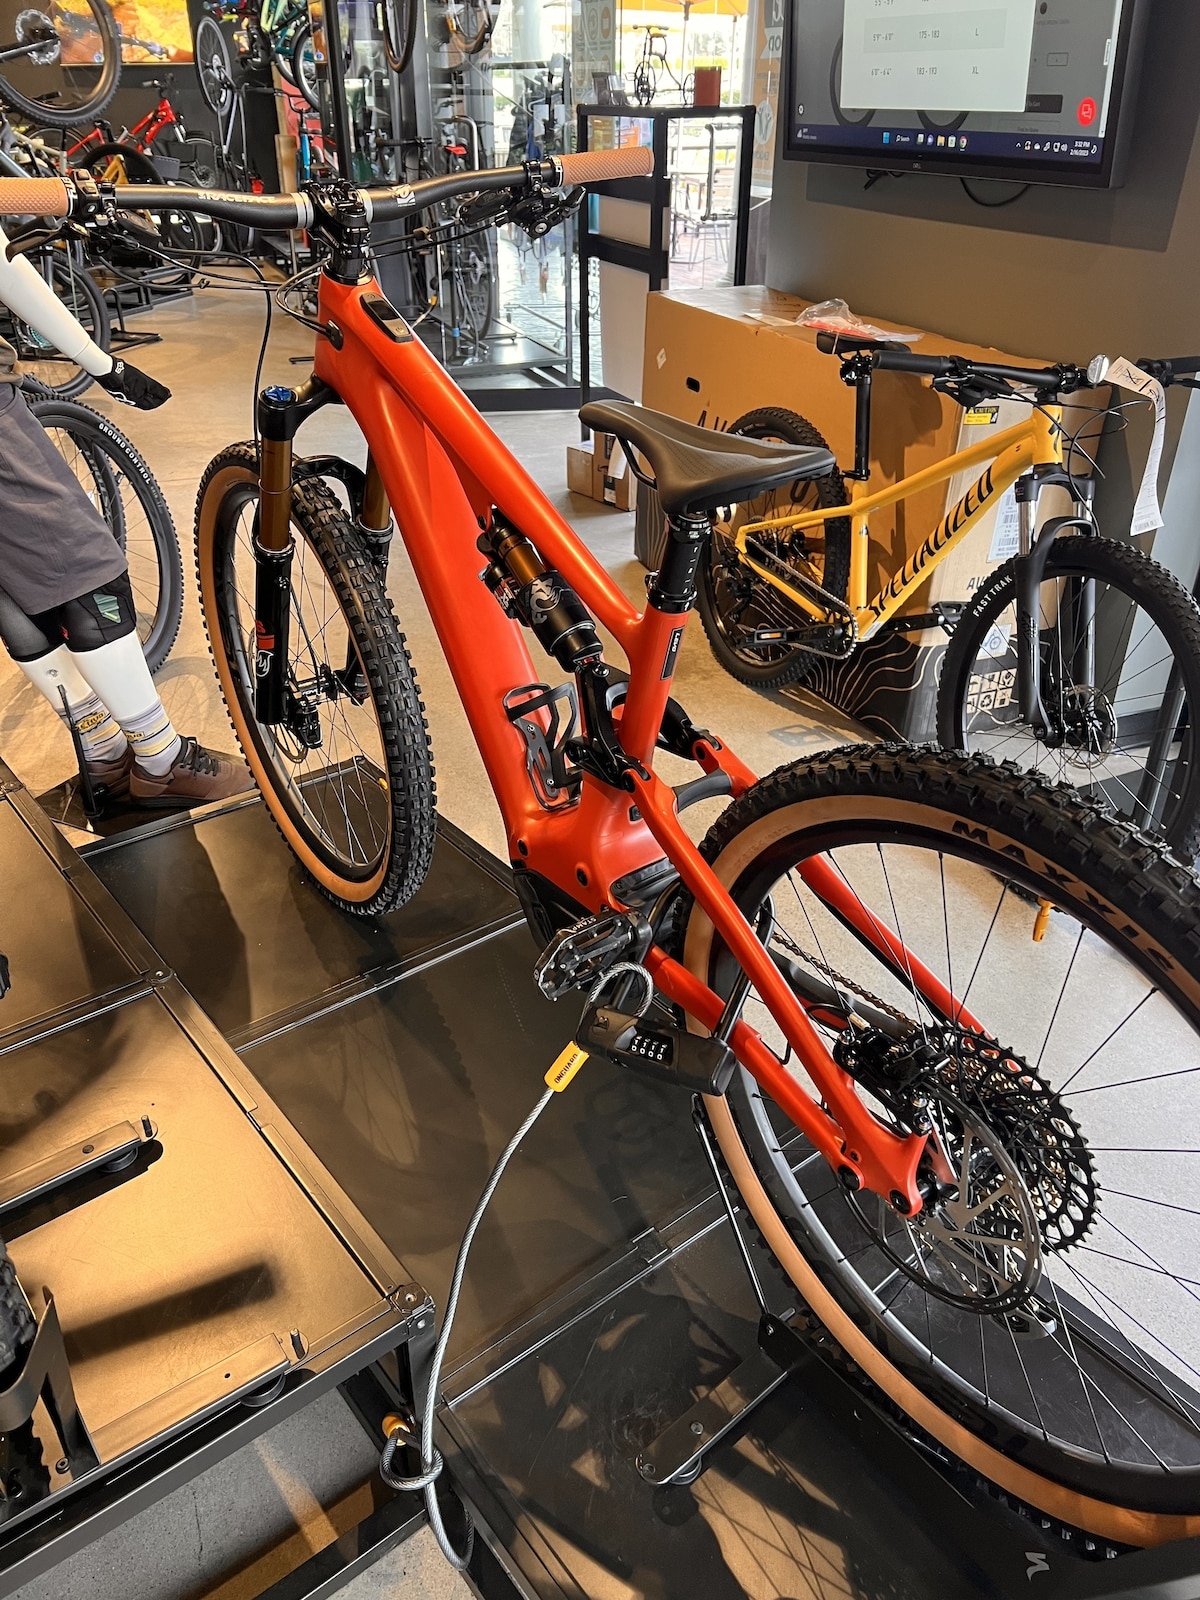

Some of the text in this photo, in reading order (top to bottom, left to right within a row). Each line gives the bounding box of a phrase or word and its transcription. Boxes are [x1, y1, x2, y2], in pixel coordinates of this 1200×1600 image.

[98, 422, 126, 449] GROUND
[125, 447, 151, 485] CONTROL
[868, 464, 994, 624] SPECIALIZED
[972, 593, 992, 618] FAST
[989, 574, 1013, 598] TRAK
[671, 632, 681, 653] LEVO
[951, 819, 1175, 971] MAXXIS
[572, 917, 597, 931] STAMP
[553, 1053, 578, 1084] ONGUARD
